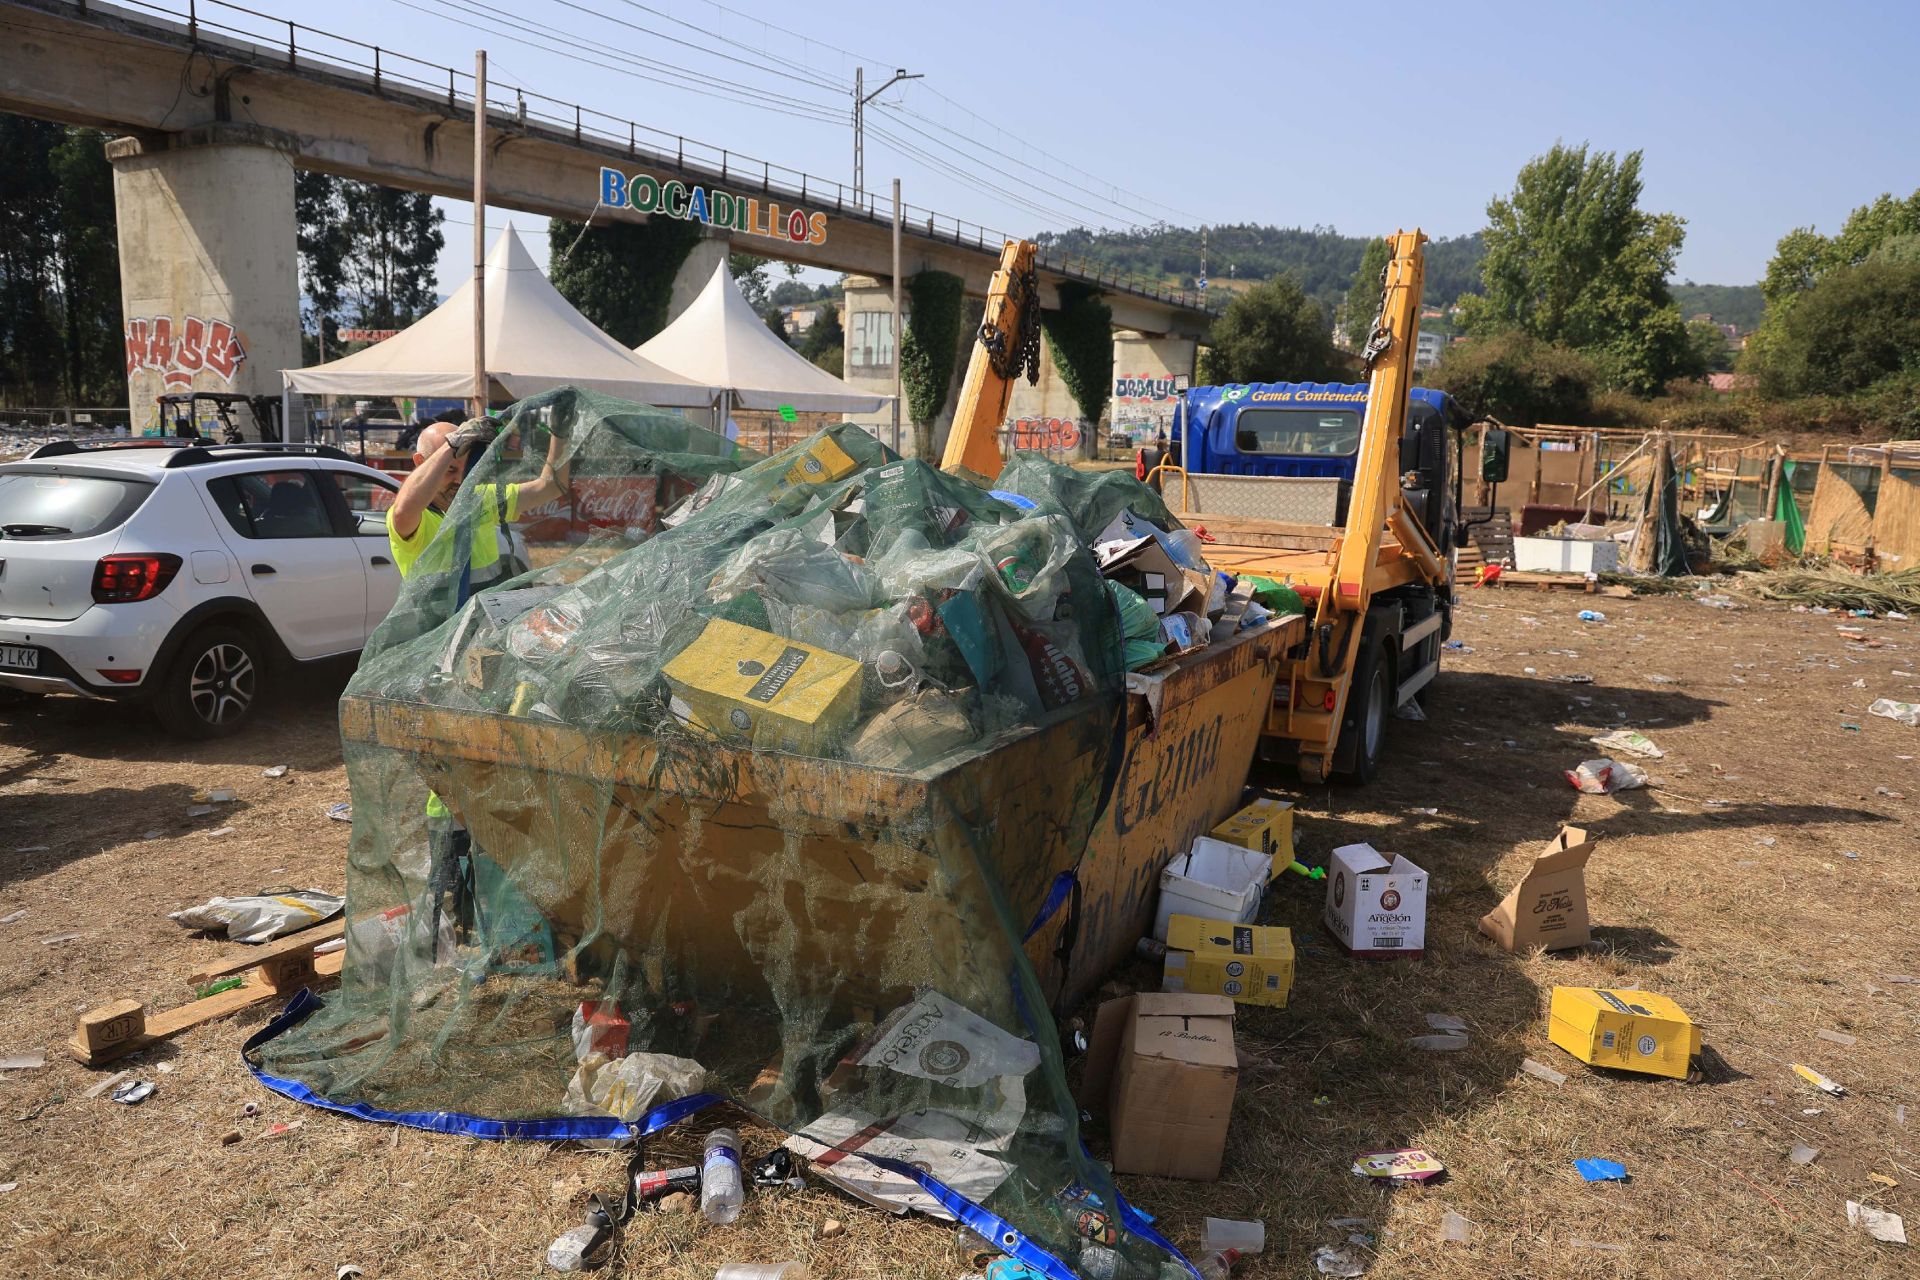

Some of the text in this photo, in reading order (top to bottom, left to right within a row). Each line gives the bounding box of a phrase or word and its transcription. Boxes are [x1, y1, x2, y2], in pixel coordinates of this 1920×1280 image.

[600, 167, 828, 246] BOCADILLOS
[1251, 390, 1369, 403] Gema Contenedo
[8, 648, 36, 667] LKK
[1368, 913, 1411, 925] Angelón
